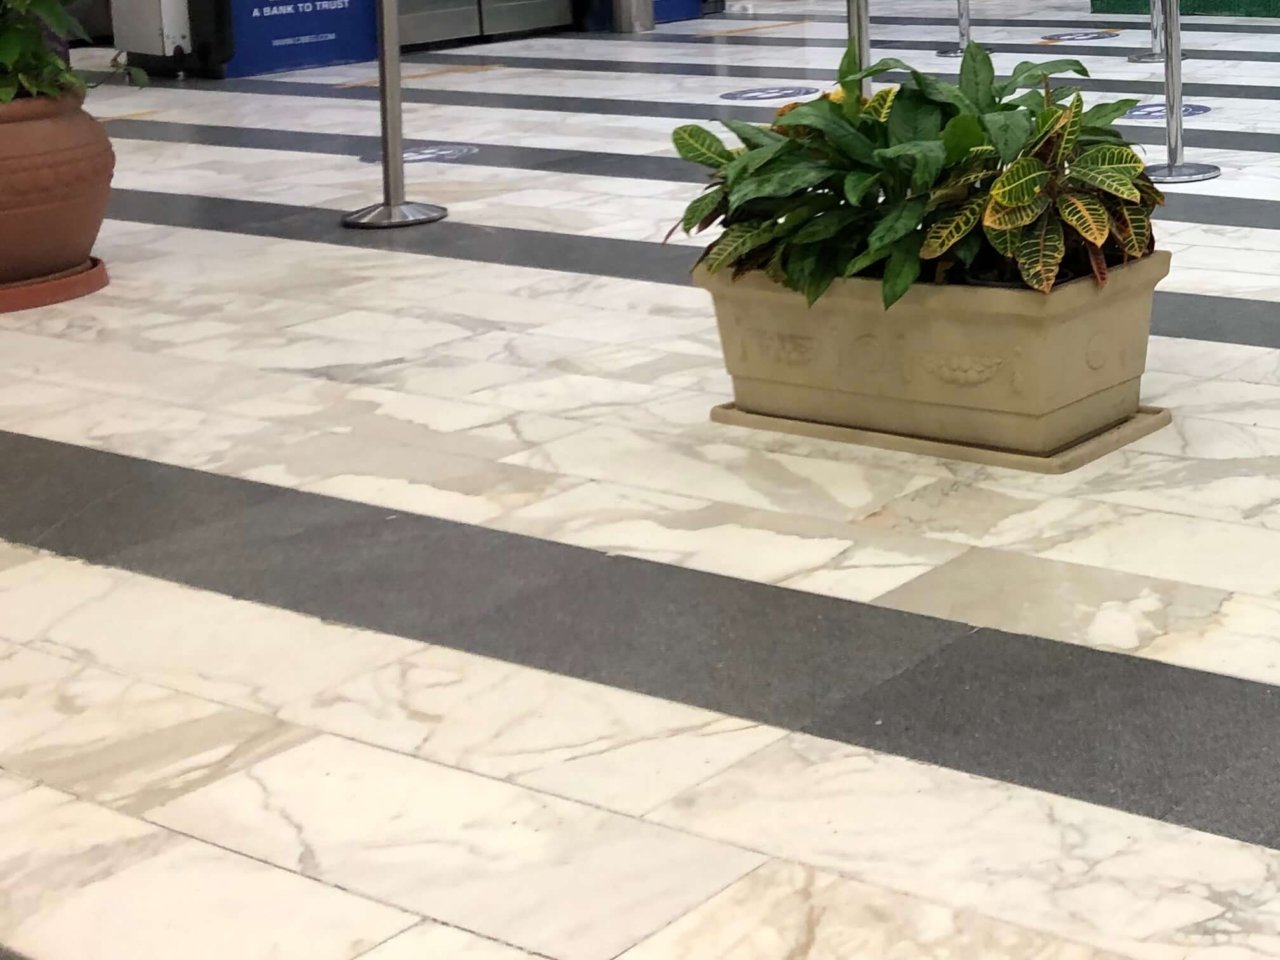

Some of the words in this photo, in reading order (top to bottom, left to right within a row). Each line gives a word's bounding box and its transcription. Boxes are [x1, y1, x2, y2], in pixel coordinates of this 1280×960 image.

[252, 8, 260, 17] A
[263, 4, 294, 17] BANK
[297, 3, 312, 12] TO
[315, 0, 350, 11] TRUST
